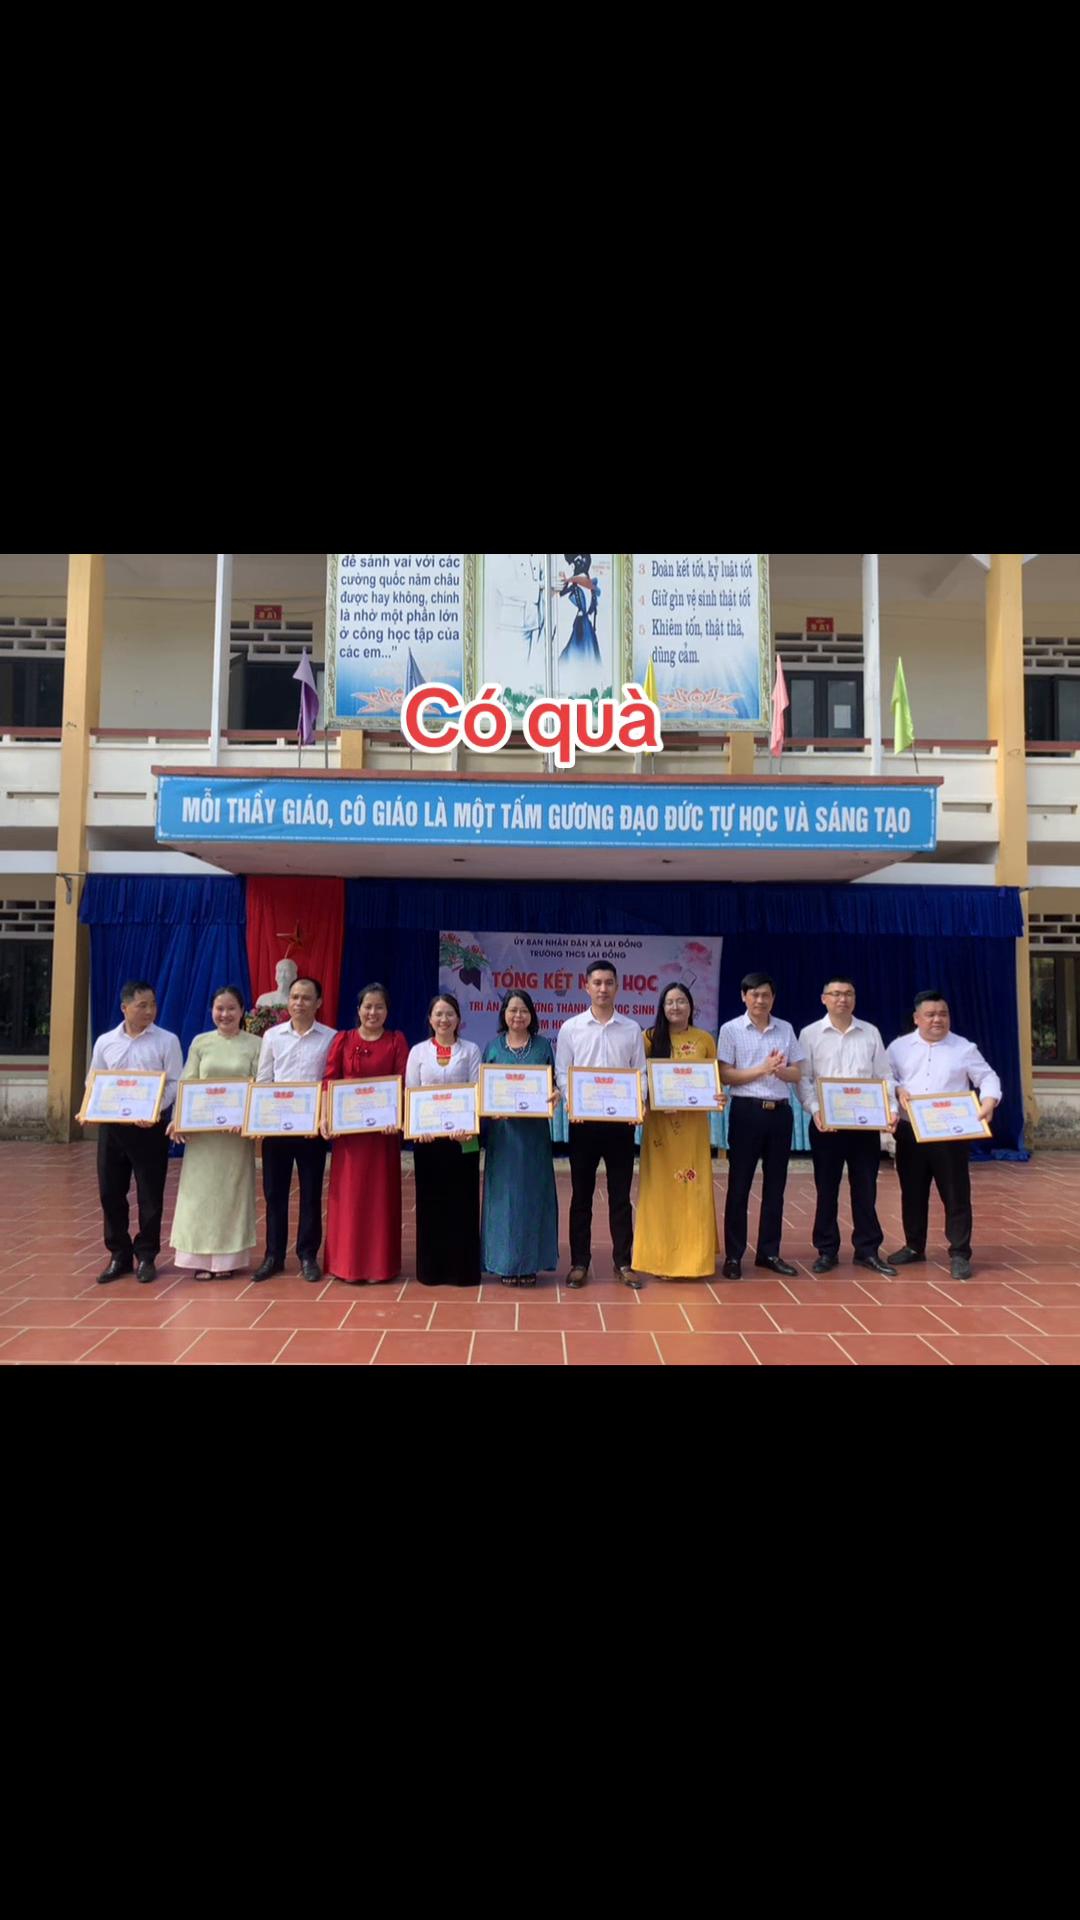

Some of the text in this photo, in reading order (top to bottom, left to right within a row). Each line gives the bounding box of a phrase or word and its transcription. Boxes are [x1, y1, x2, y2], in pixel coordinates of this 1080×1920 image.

[360, 555, 389, 567] sánh
[394, 555, 412, 567] vai
[416, 555, 435, 567] với
[439, 555, 460, 567] các
[652, 560, 674, 577] Đoàn
[676, 557, 690, 577] kết
[692, 557, 706, 578] tốt,
[708, 556, 719, 581] kỷ
[721, 560, 738, 581] luật
[740, 558, 752, 577] tốt
[341, 570, 459, 588] cường quốc năm châu
[340, 591, 459, 607] được hay không, chính
[652, 589, 668, 606] Giữ
[669, 588, 684, 611] gìn
[686, 589, 696, 611] vệ
[698, 589, 717, 606] sinh
[719, 589, 736, 611] thật
[739, 586, 751, 607] tốt
[340, 607, 458, 625] là nhờ một phần lớn
[340, 626, 459, 643] ở công học tập của
[652, 618, 682, 636] Khiêm
[685, 615, 703, 638] tốn,
[705, 618, 724, 640] thật
[726, 618, 744, 639] thà,
[340, 645, 360, 658] các
[652, 641, 700, 668] dũng cảm.
[182, 787, 910, 839] MỖI THẦY GIÁO, CÔ GIÁO LÀ MỘT TẤM GƯƠNG ĐẠO ĐỨC TỰ HỌC VÀ SÁNG TẠO
[545, 938, 568, 946] NHÂN
[566, 950, 586, 958] THCS
[492, 965, 538, 988] TỔNG
[543, 967, 574, 989] KẾT
[622, 974, 659, 995] HỌC
[469, 1002, 483, 1012] TRI
[632, 1004, 655, 1015] SINH
